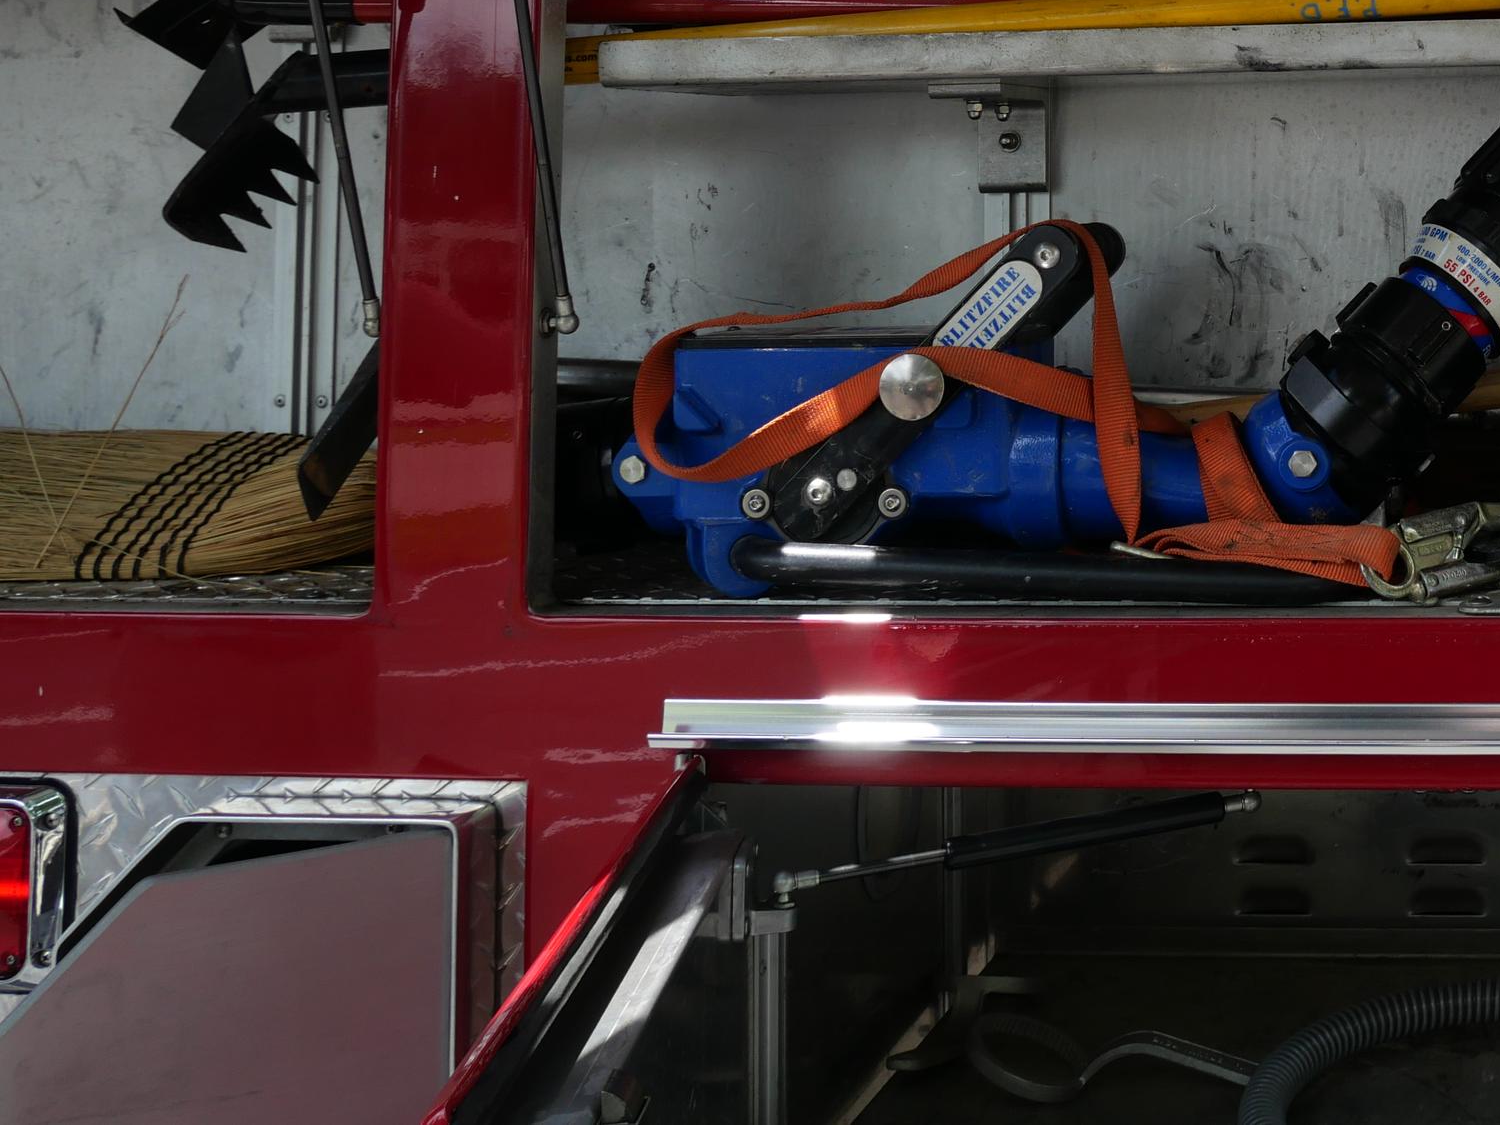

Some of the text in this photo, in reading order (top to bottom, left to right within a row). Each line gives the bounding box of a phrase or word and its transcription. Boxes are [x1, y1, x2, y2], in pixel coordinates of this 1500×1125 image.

[1429, 227, 1448, 242] GPM
[1456, 244, 1488, 270] 400-2000
[1443, 258, 1459, 273] 55
[1457, 269, 1476, 287] PSI
[1477, 291, 1492, 306] BAR
[939, 266, 1021, 347] BLITZFIRE
[968, 283, 1037, 349] BLITZFI
